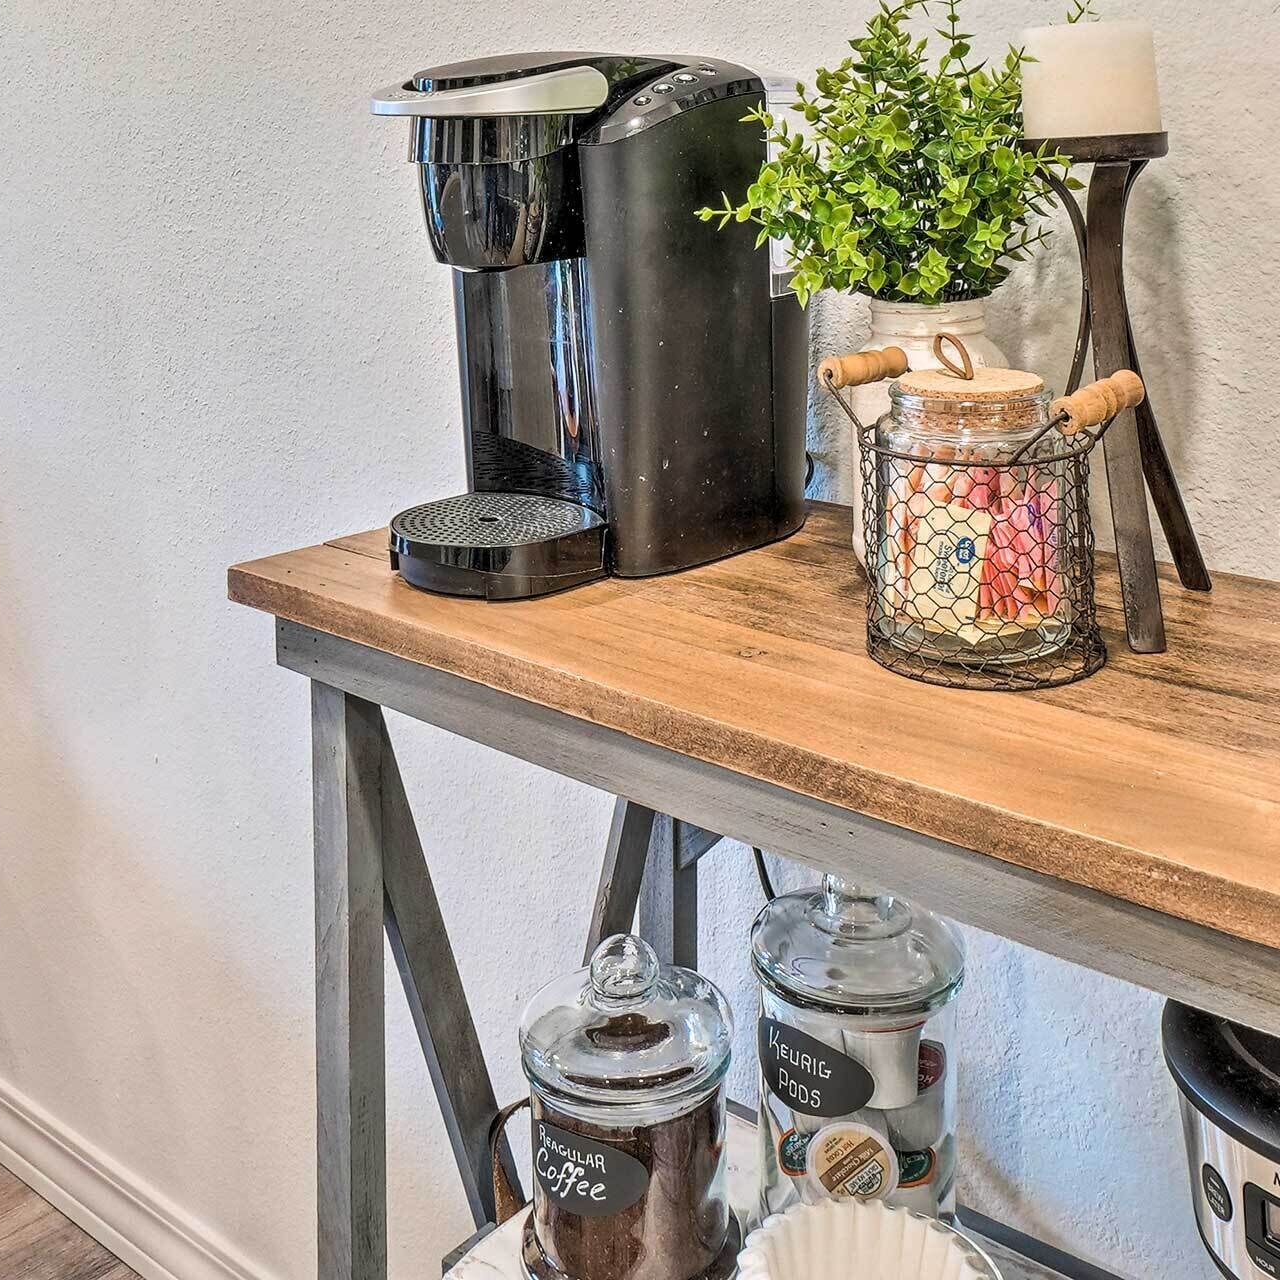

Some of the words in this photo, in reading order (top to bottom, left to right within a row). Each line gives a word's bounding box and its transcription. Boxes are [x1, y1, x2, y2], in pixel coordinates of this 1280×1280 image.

[768, 1025, 832, 1079] KEURIG
[778, 1067, 821, 1108] PODS
[536, 1147, 607, 1201] Coffee
[539, 1124, 607, 1174] REAGULAR
[1255, 1256, 1276, 1274] HOUR
